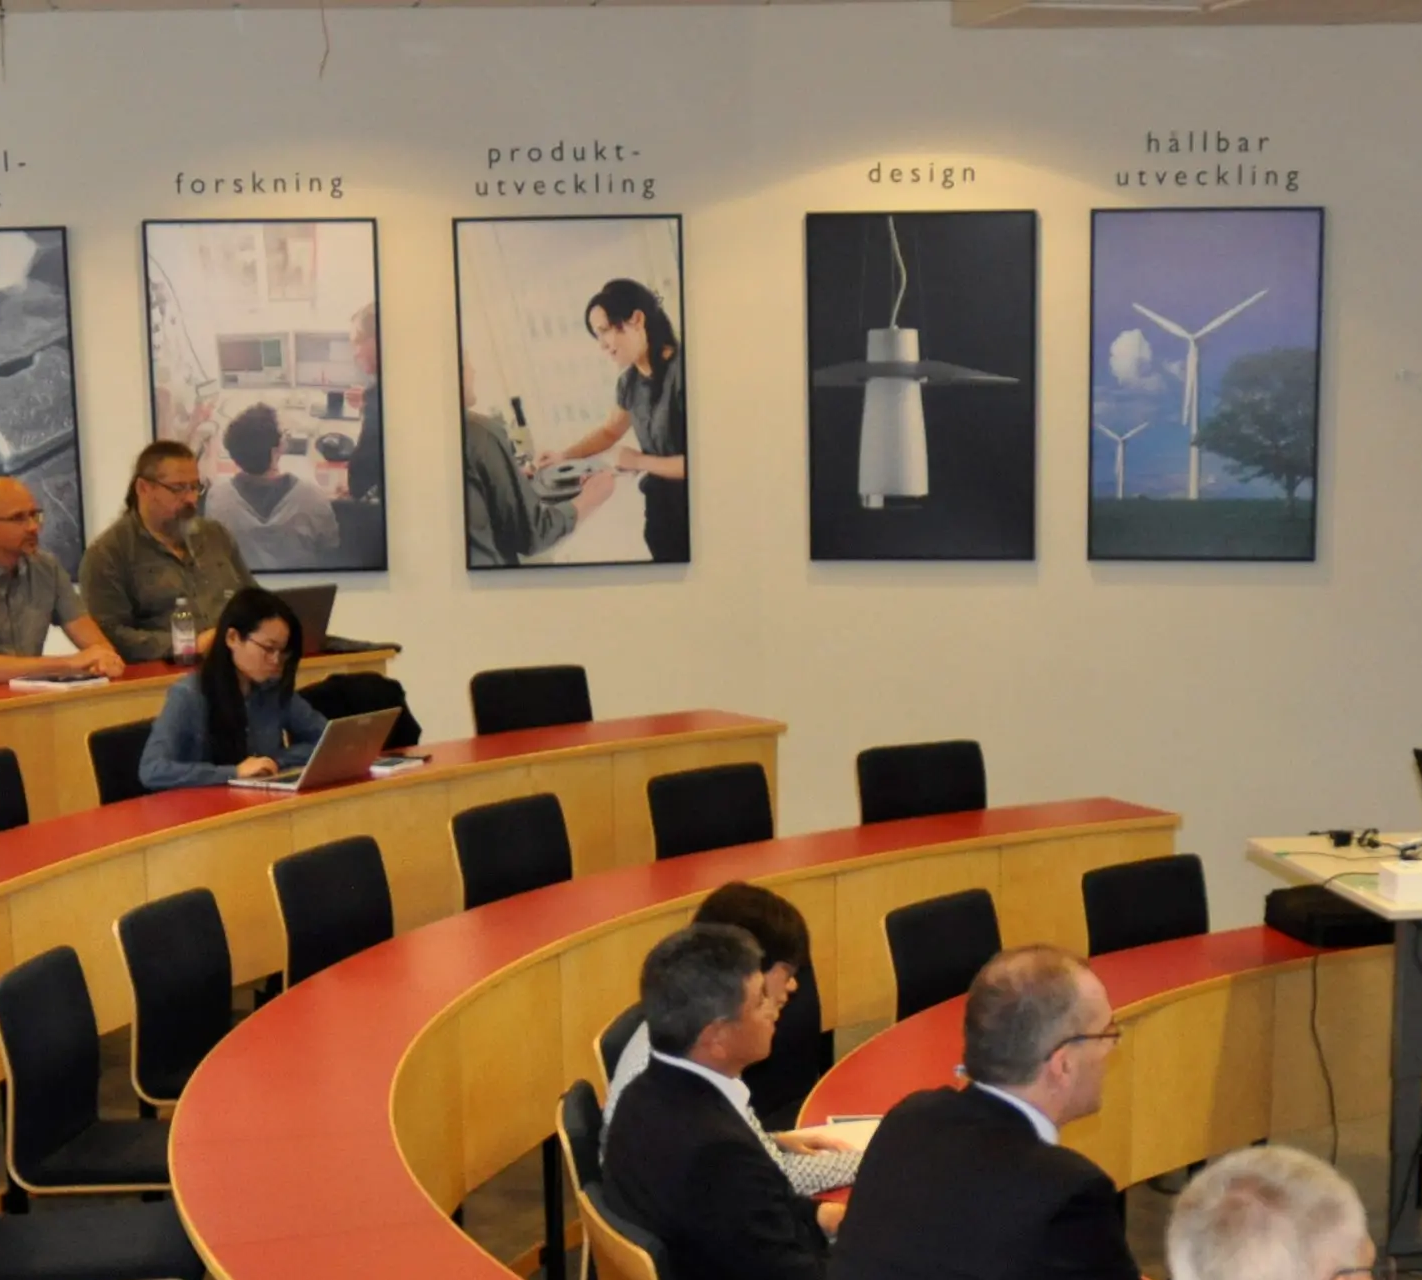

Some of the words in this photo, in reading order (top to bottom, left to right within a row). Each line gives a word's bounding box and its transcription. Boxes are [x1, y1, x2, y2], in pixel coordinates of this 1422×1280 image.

[487, 139, 640, 169] produkt-
[1146, 130, 1270, 154] hållbar
[175, 171, 345, 199] forskning
[475, 173, 658, 200] utveckling
[867, 162, 977, 189] design
[1116, 164, 1300, 192] utveckling
